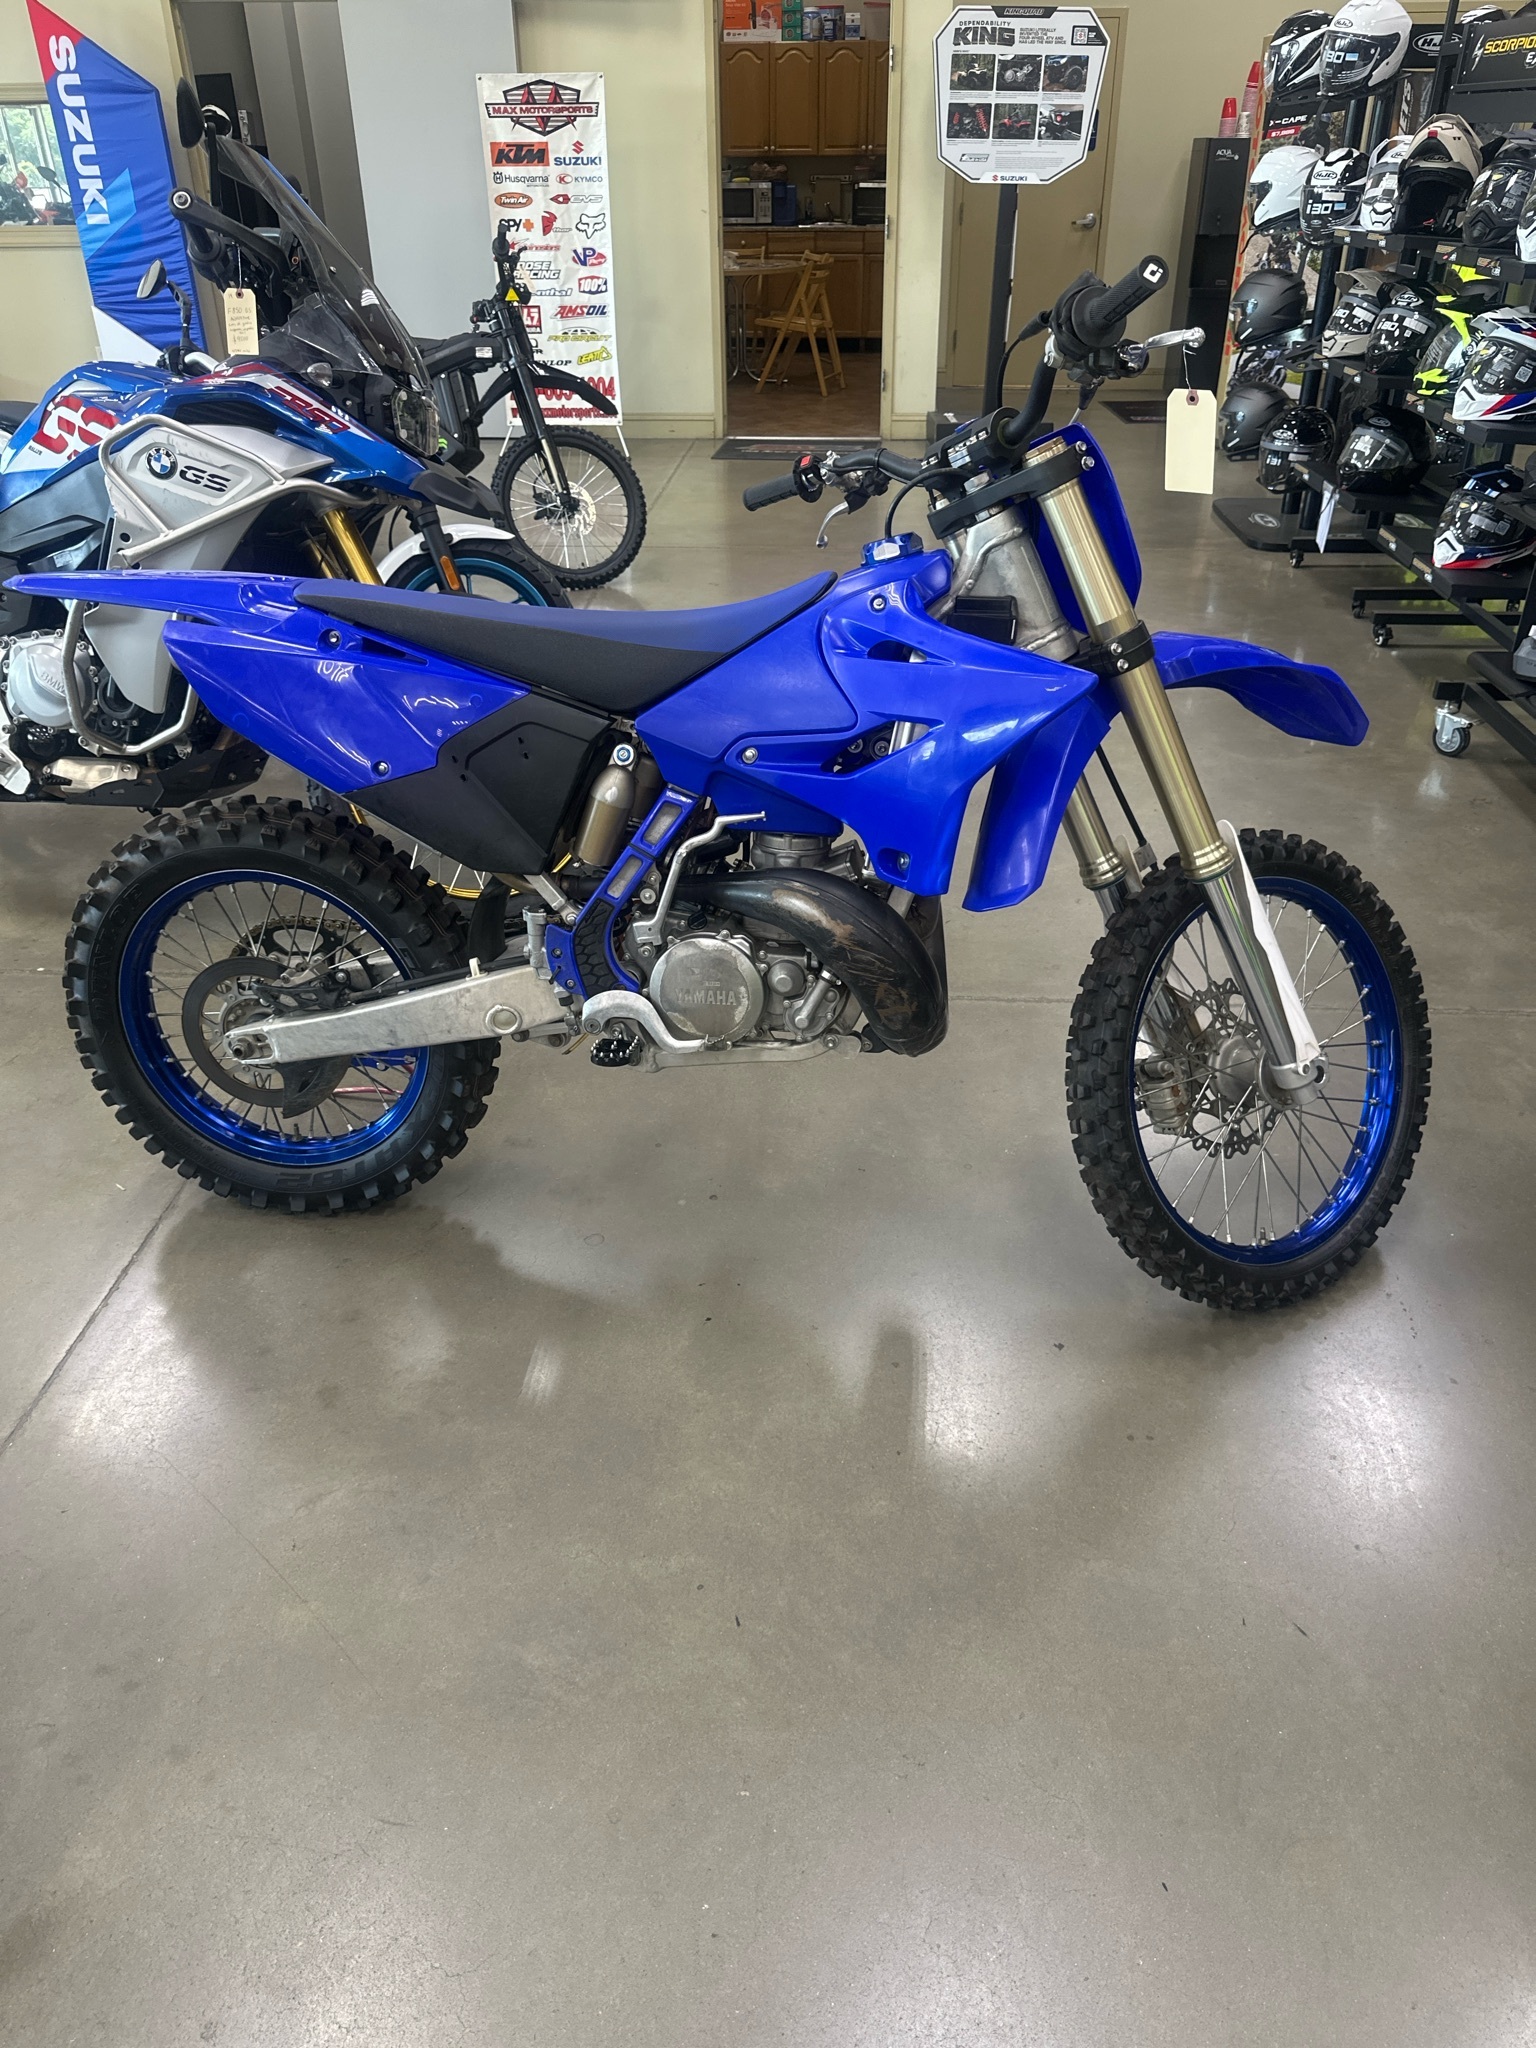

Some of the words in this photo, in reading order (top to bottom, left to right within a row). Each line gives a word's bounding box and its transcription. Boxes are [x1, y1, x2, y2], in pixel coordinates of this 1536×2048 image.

[952, 26, 1015, 47] KING
[1484, 35, 1536, 54] SCORPIO
[492, 106, 518, 115] MAX
[519, 105, 594, 115] MOTORSPORTS
[49, 34, 111, 225] SUZUKI
[494, 143, 546, 165] KTM
[554, 156, 602, 166] SUZUKI
[504, 174, 549, 185] Husqvarna
[1306, 199, 1333, 215] i30
[572, 247, 597, 266] VP
[579, 278, 608, 292] 100%
[554, 304, 608, 319] AMSOIL
[178, 464, 232, 493] GS
[675, 988, 737, 1006] YAMAHA
